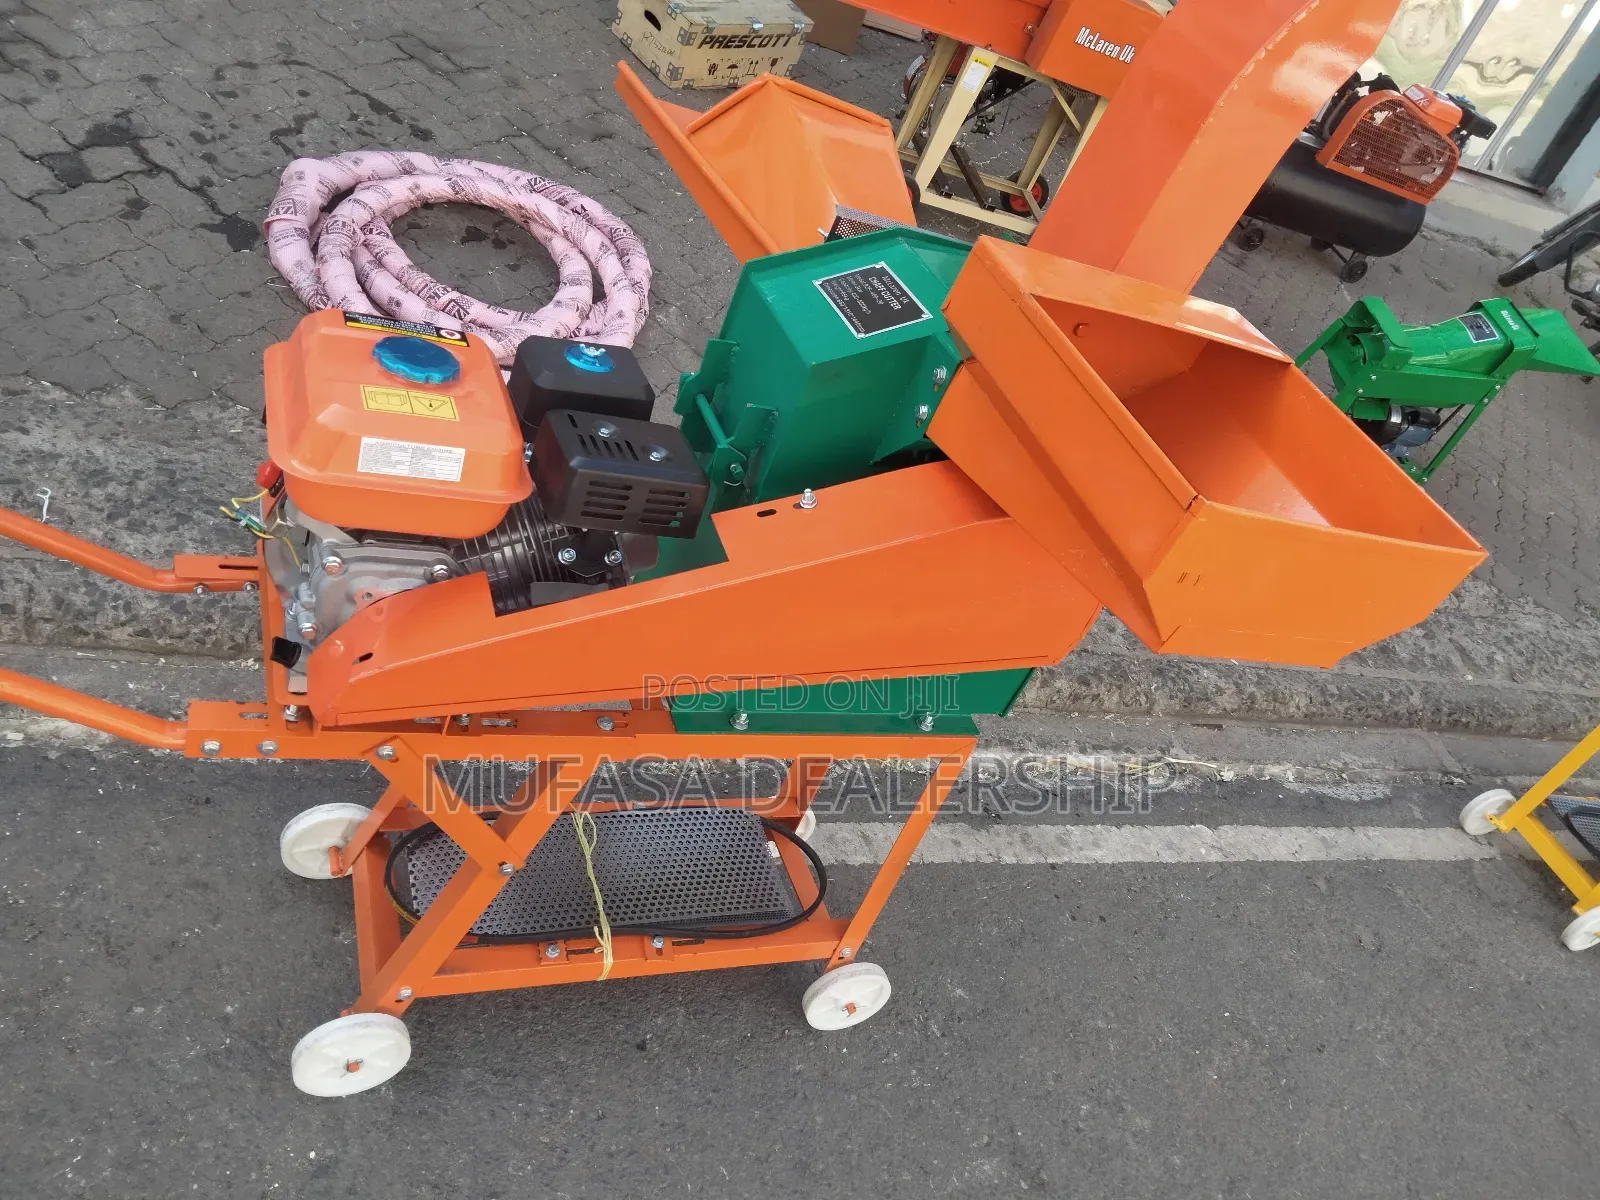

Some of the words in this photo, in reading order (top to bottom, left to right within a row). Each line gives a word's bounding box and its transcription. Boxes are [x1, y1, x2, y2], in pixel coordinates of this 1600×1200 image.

[697, 31, 798, 50] PRESCOTT
[1074, 26, 1121, 59] McLaren
[1119, 44, 1136, 64] Uk
[881, 291, 902, 310] CUTTER
